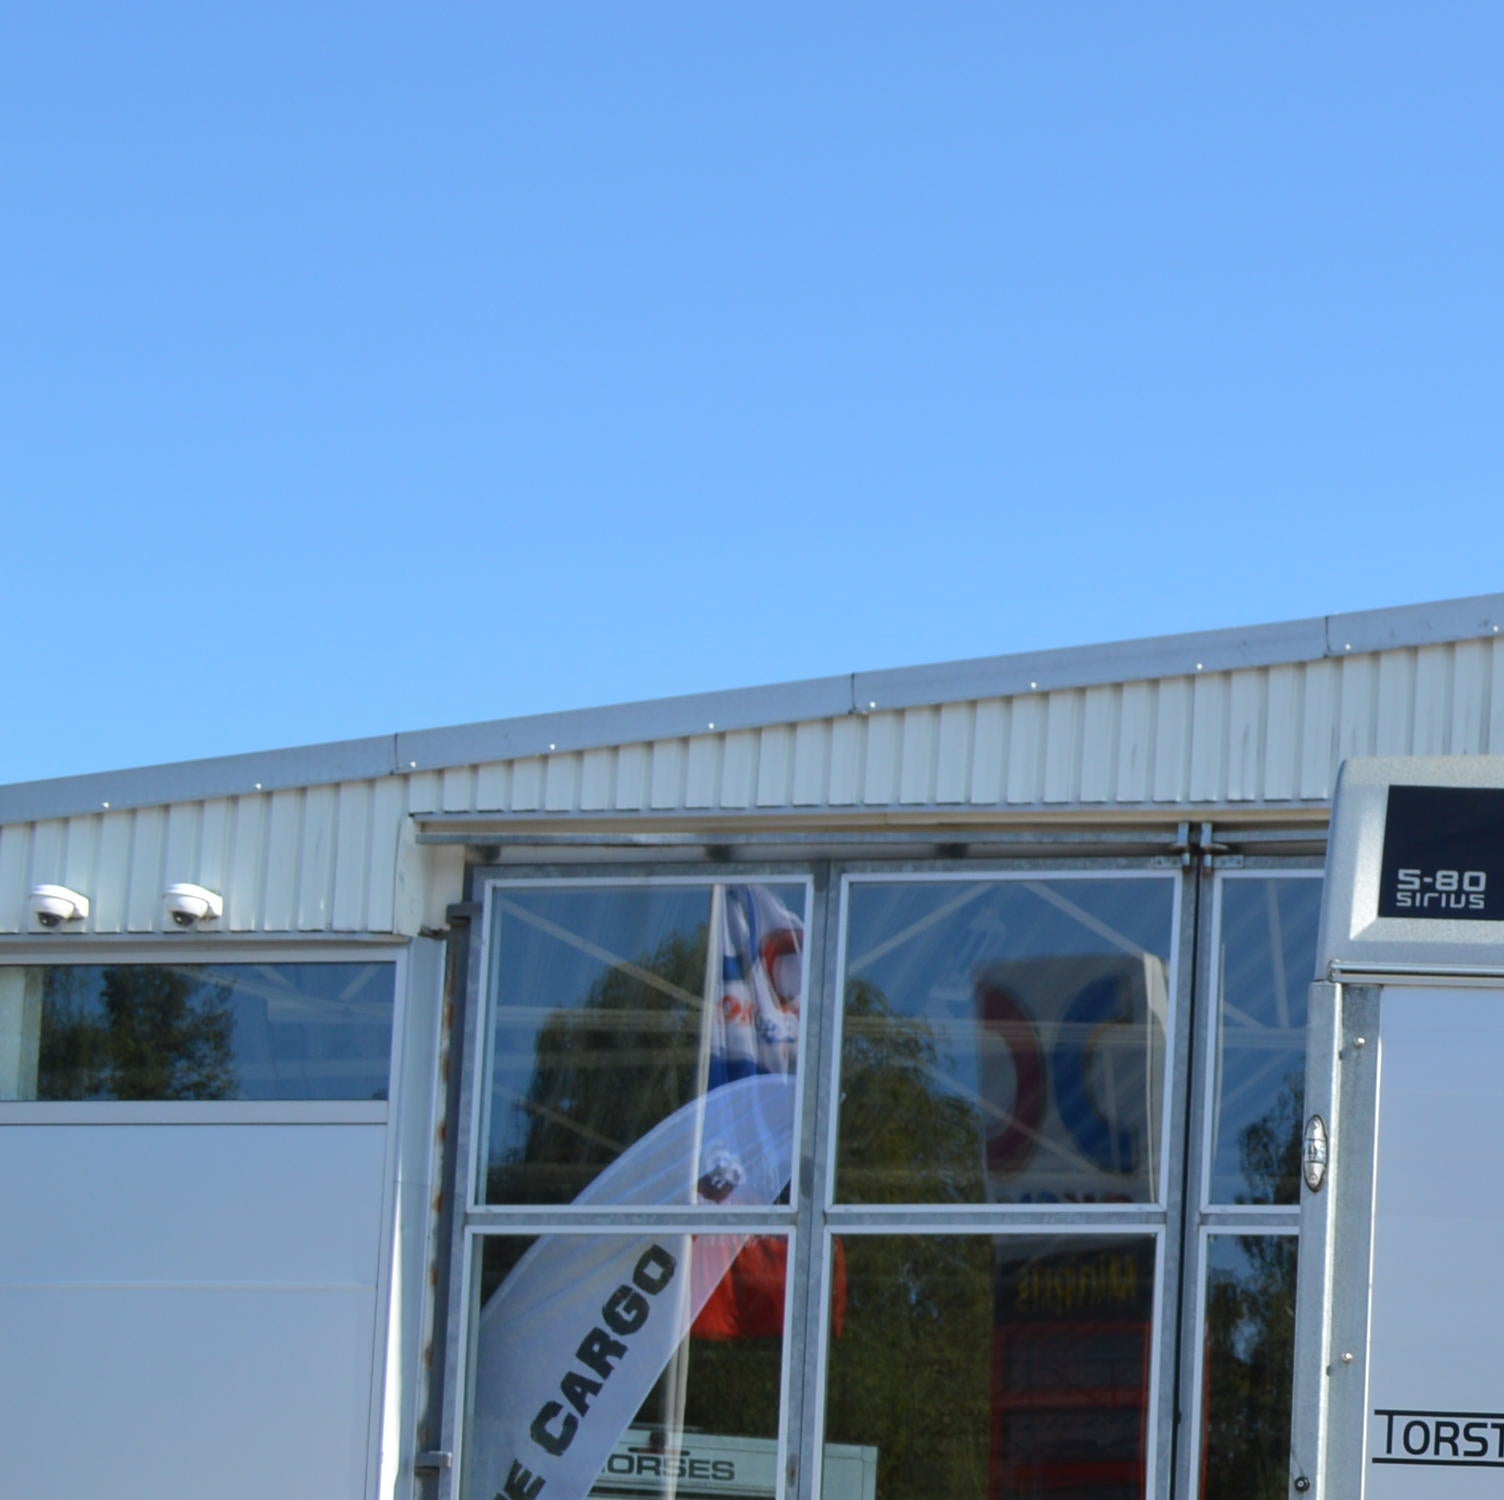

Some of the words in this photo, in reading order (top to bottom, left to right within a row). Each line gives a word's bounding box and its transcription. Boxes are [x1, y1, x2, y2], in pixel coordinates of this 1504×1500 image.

[1397, 869, 1486, 892] S-80
[530, 1244, 676, 1457] CARGO
[602, 1454, 735, 1482] ORSES
